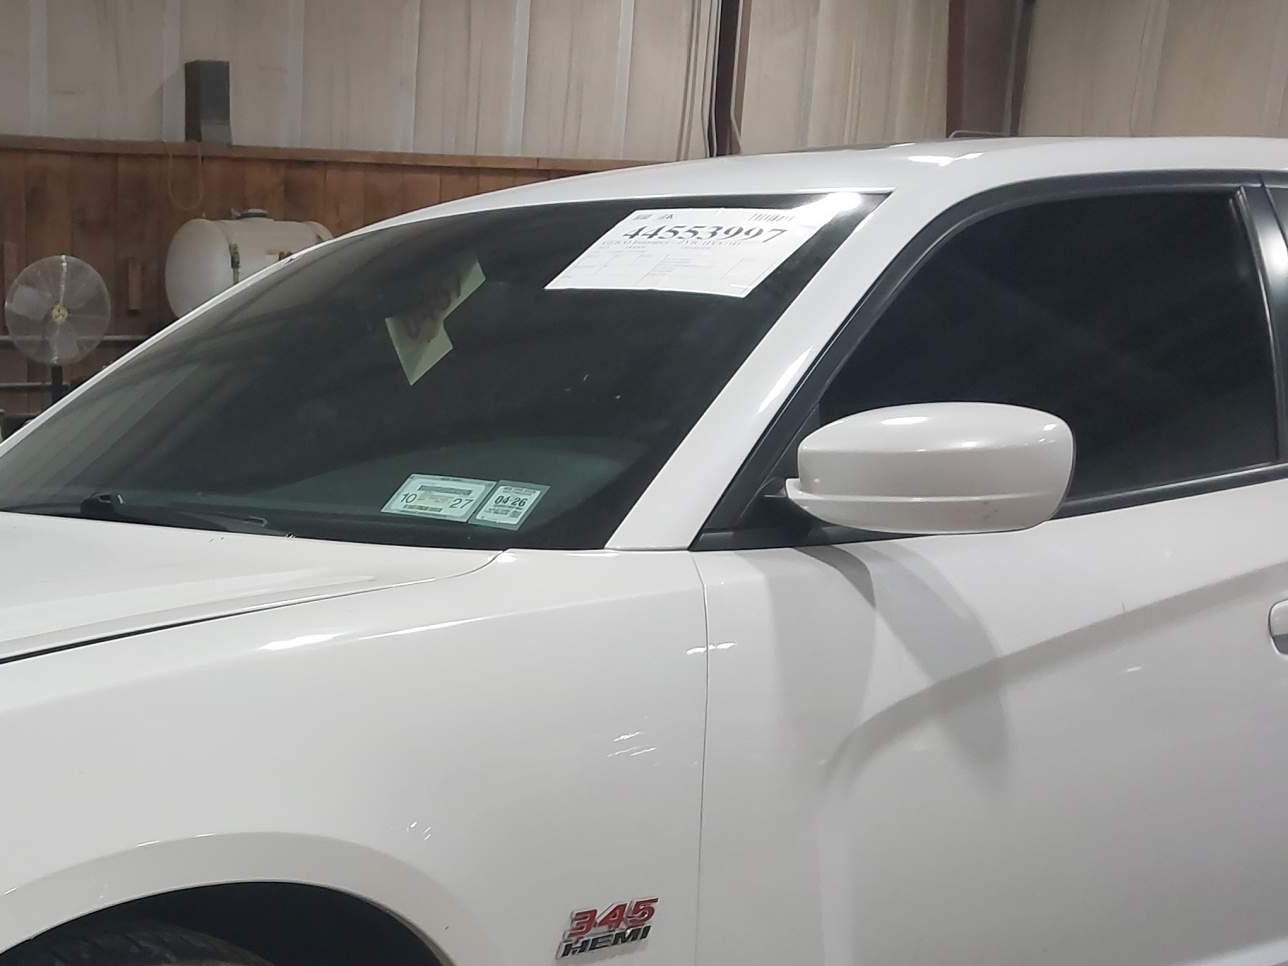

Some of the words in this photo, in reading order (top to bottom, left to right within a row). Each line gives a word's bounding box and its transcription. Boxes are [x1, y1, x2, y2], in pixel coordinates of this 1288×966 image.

[624, 225, 788, 243] 44553997
[400, 492, 417, 504] 10
[449, 498, 473, 510] 27
[567, 897, 659, 937] 345
[560, 925, 652, 957] HEMI
